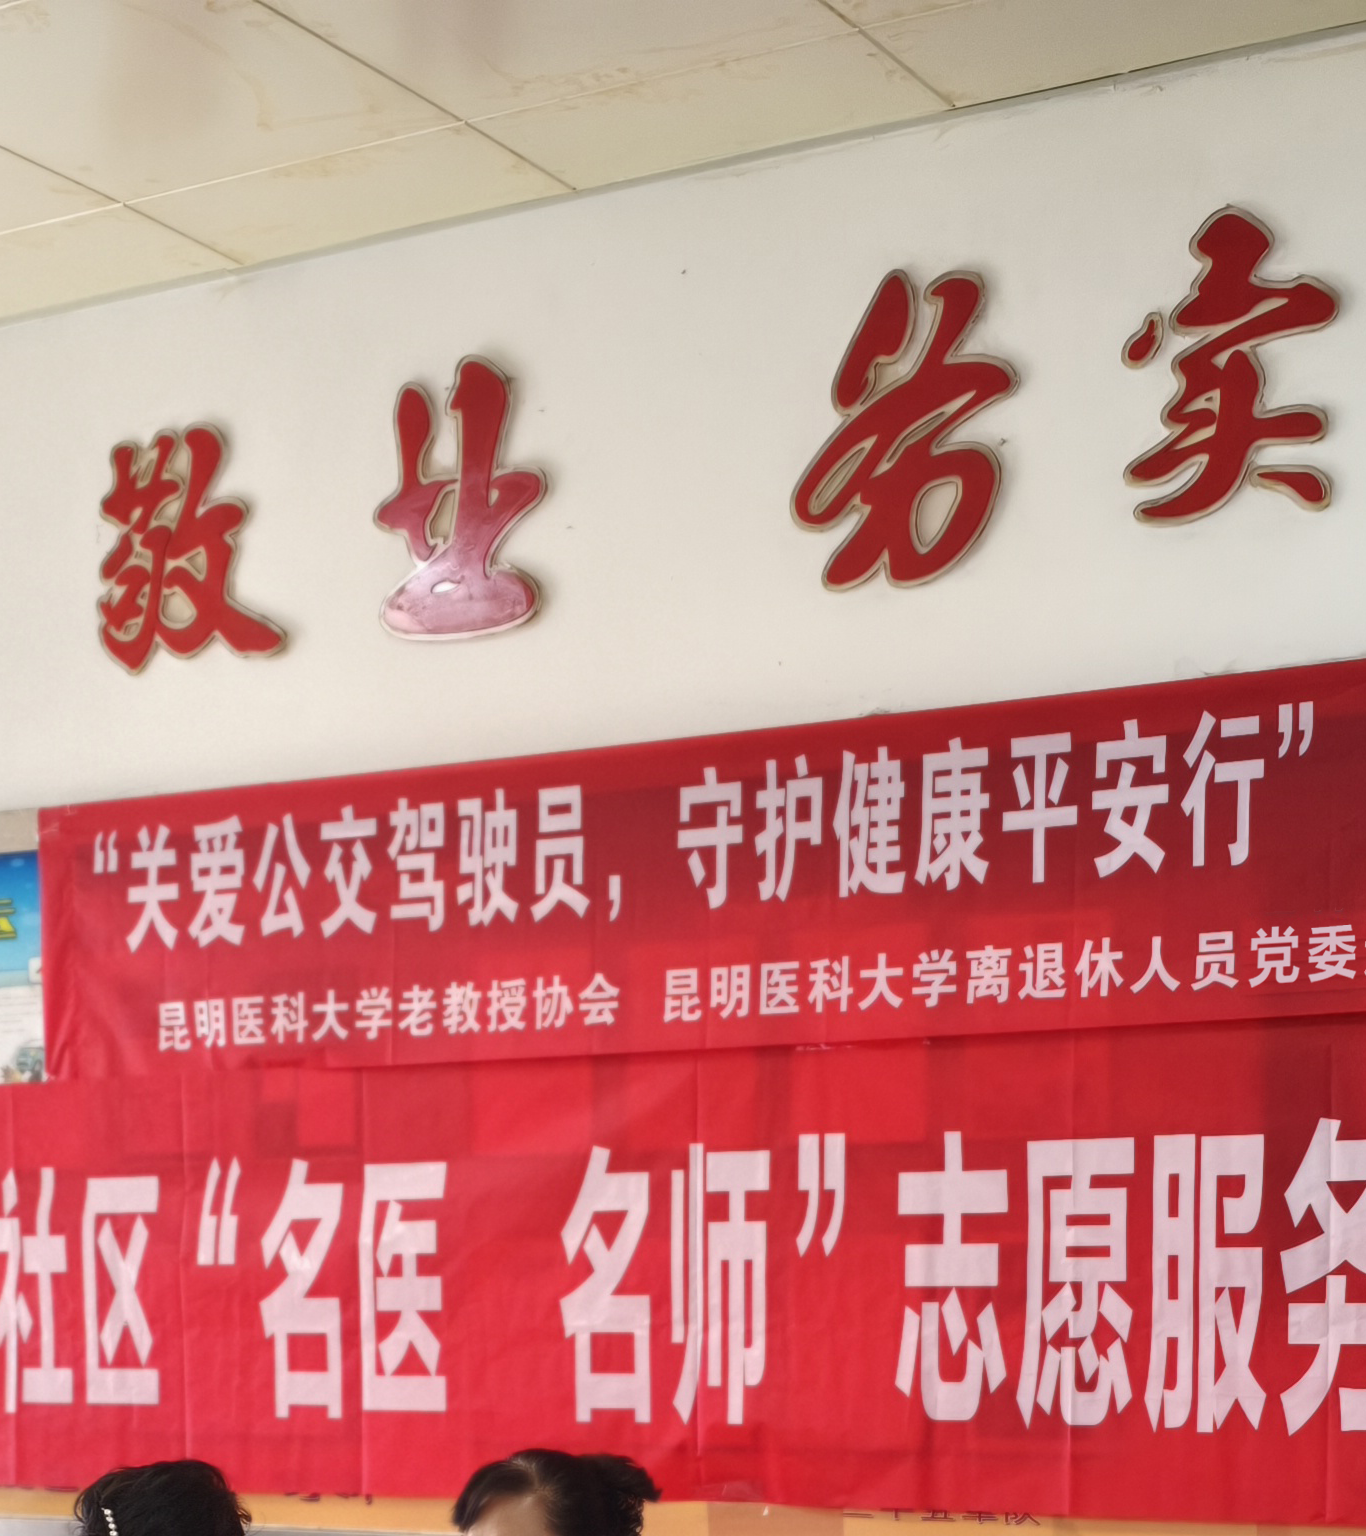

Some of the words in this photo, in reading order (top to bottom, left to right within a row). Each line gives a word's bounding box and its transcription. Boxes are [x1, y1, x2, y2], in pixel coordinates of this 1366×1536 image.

[157, 973, 621, 1053] 昆明医科大学老教授协会
